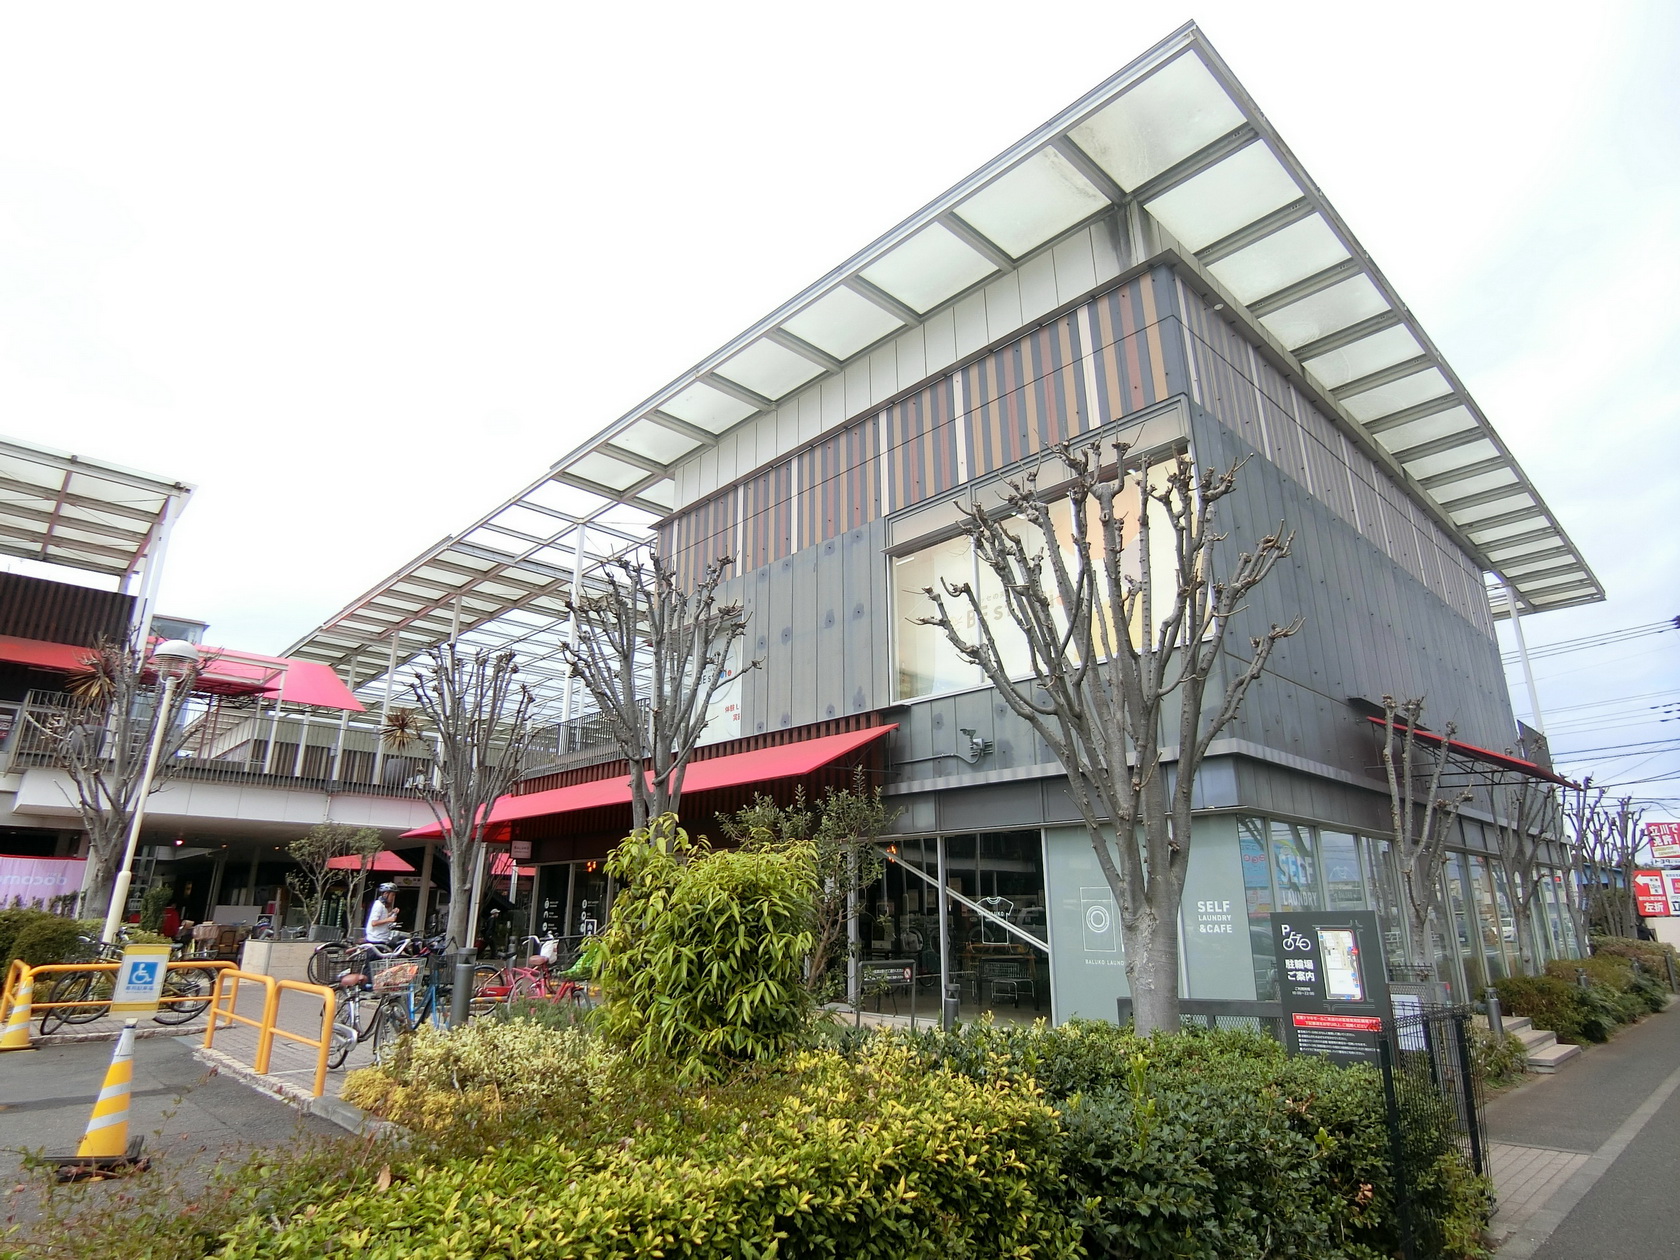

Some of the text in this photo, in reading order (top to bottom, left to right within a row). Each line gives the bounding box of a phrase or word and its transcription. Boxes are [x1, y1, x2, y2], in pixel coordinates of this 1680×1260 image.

[1649, 824, 1678, 836] 立川で
[1282, 890, 1317, 906] LAUNDRY
[1198, 901, 1230, 912] SELF
[1643, 902, 1664, 913] 左折
[1199, 924, 1233, 933] &CAFE
[1281, 924, 1290, 936] P
[1285, 959, 1314, 970] 駐輪場
[1287, 971, 1315, 982] ご案内
